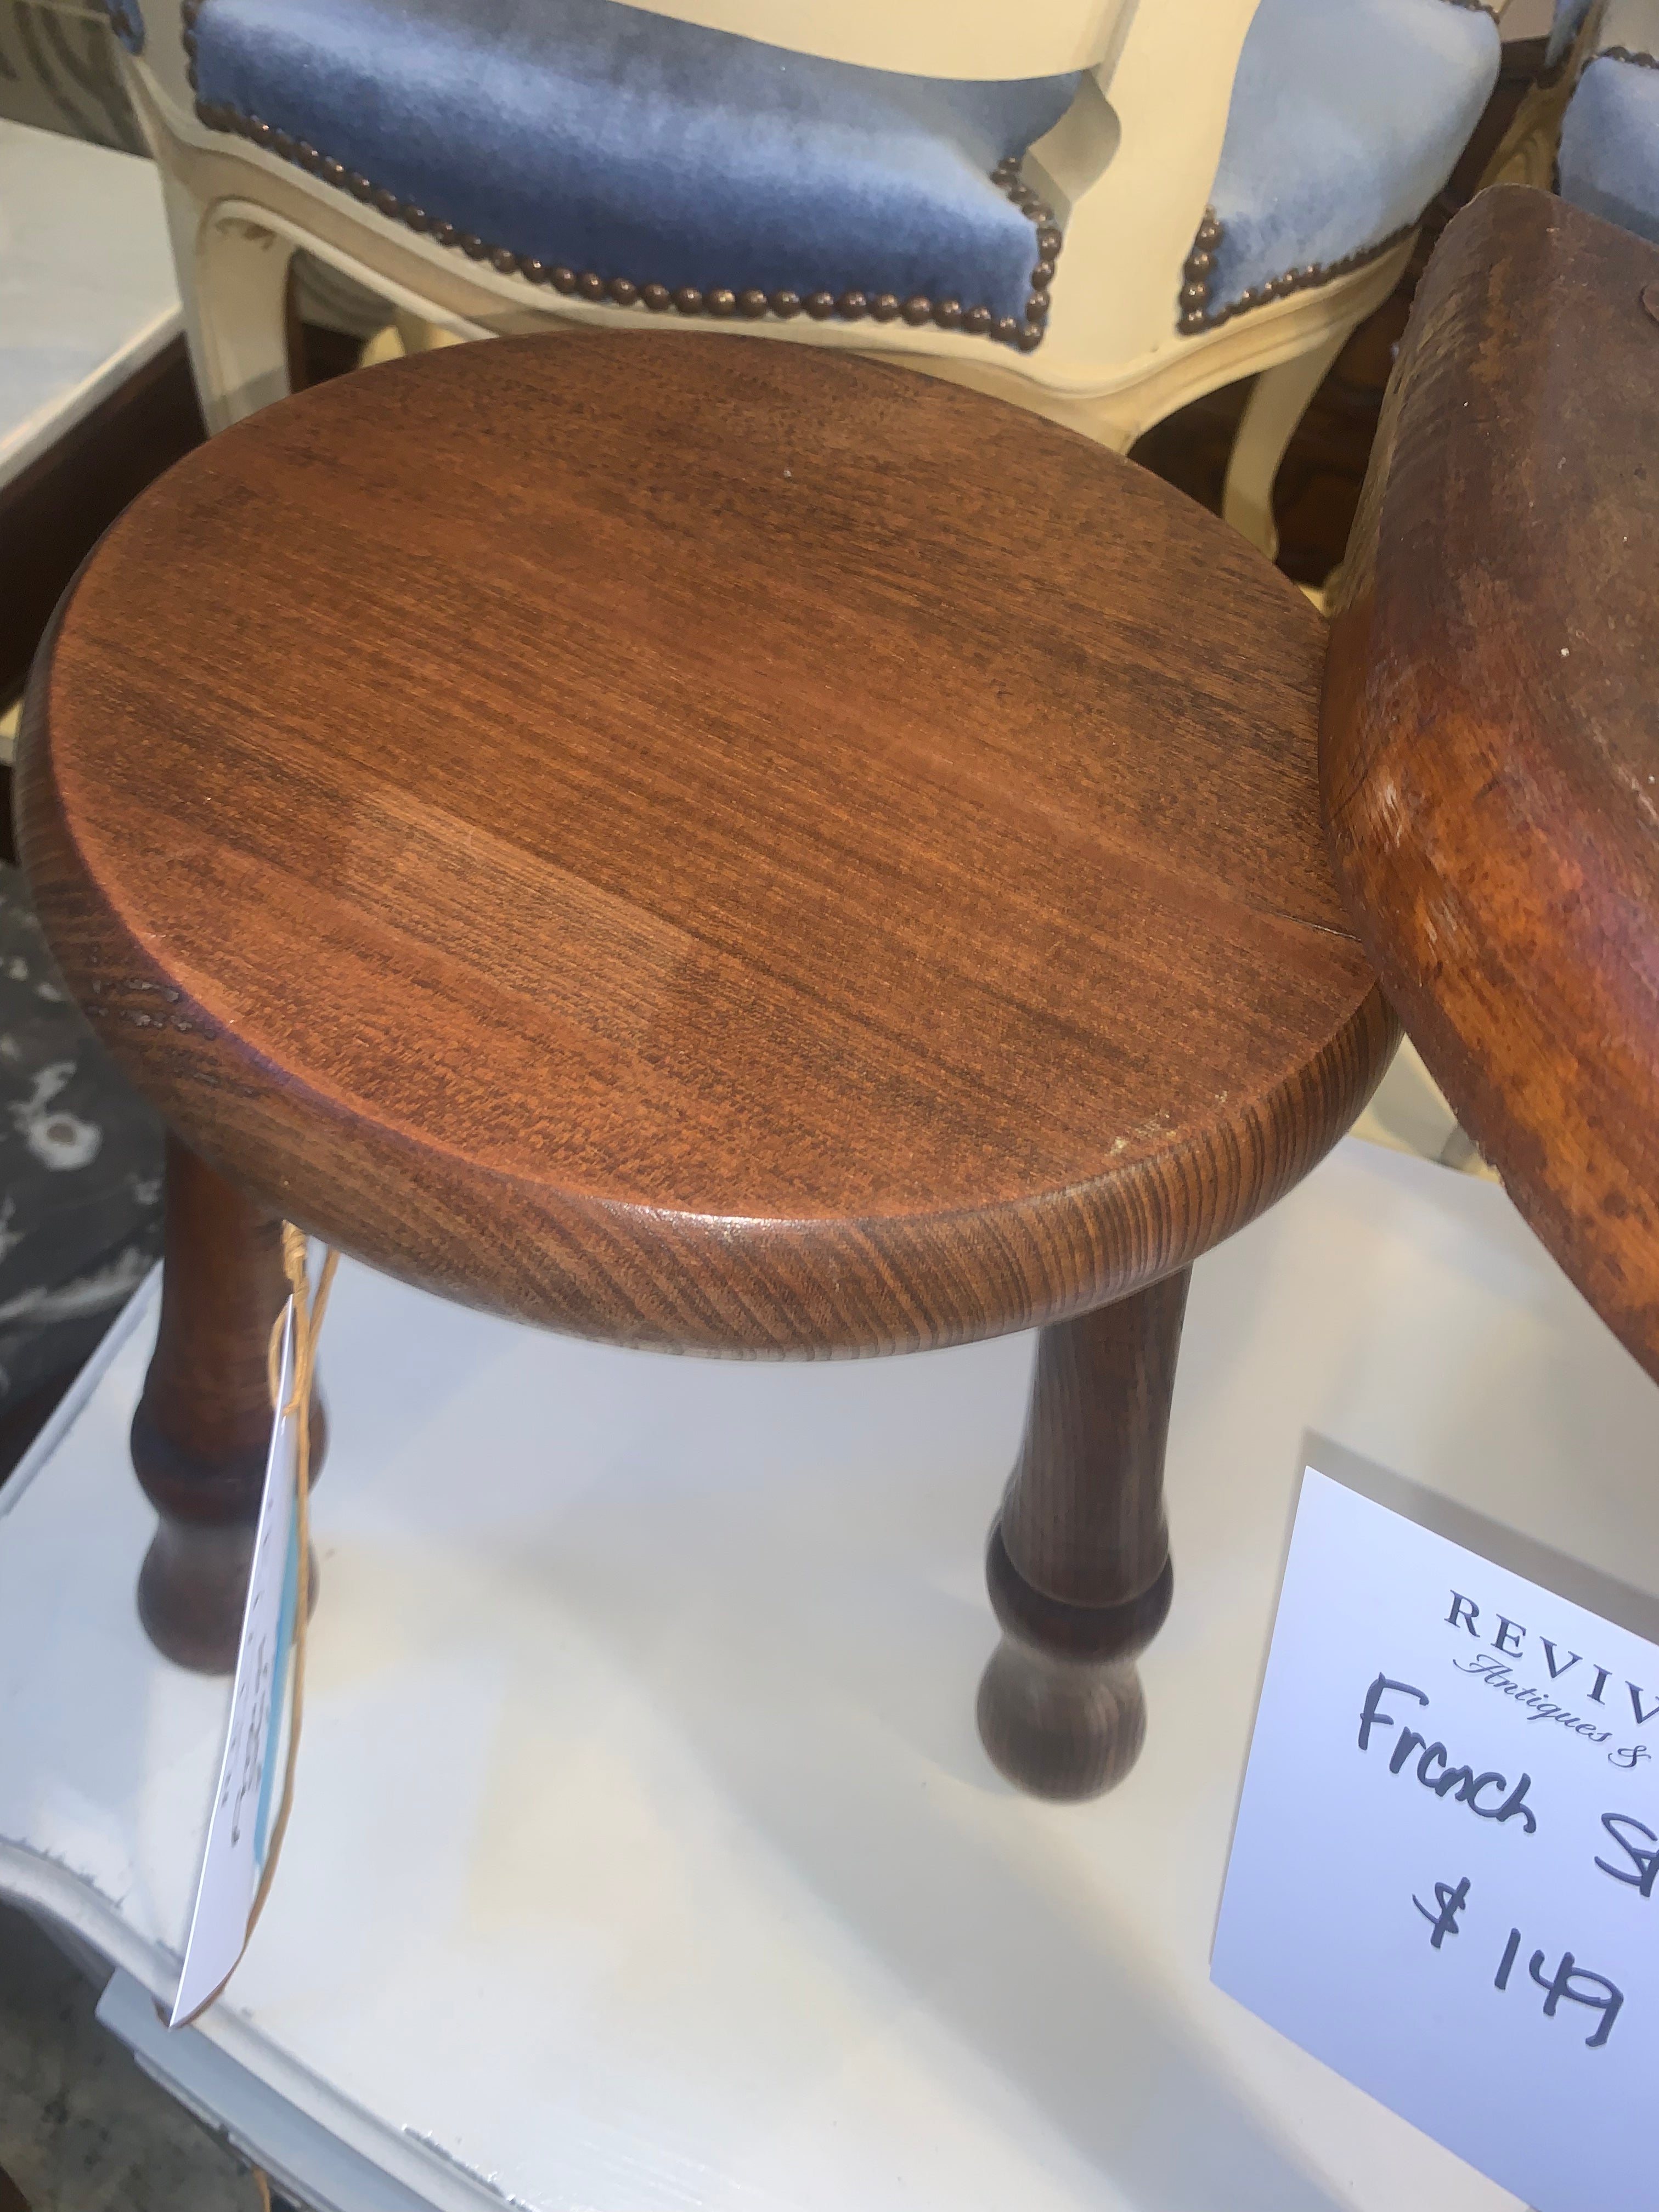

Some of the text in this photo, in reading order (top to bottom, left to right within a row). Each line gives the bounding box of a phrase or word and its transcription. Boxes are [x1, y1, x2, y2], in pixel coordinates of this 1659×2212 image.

[1443, 1589, 1659, 1725] REVIV
[1452, 1654, 1652, 1768] Antiques &
